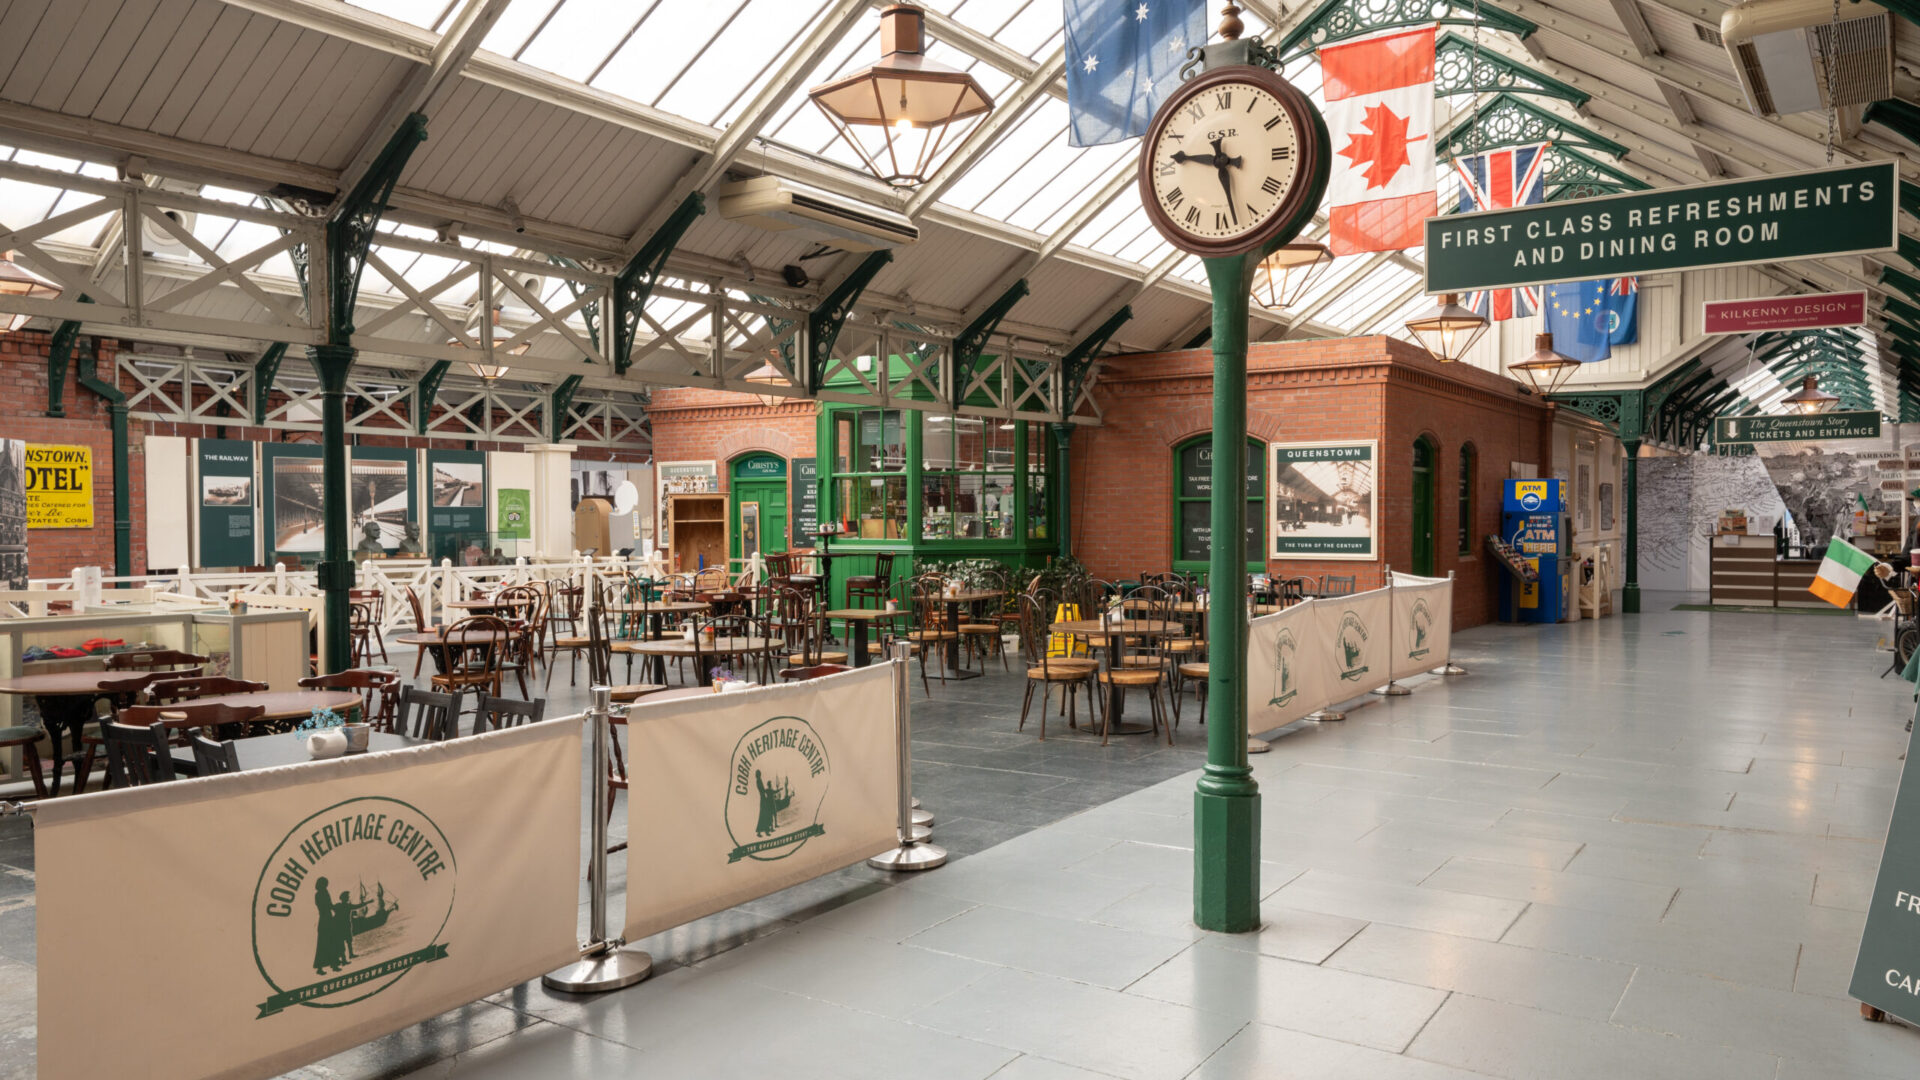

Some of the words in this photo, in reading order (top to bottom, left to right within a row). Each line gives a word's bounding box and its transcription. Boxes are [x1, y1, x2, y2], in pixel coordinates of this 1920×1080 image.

[1215, 92, 1232, 111] XII
[1186, 103, 1206, 124] XI
[1264, 115, 1281, 131] II
[1168, 130, 1184, 144] X
[1272, 147, 1289, 160] III
[1166, 187, 1185, 211] VIII
[1185, 205, 1201, 227] VII
[1441, 225, 1512, 249] FIRST
[1527, 213, 1612, 239] CLASS
[1628, 181, 1875, 228] REFRESHMENTS
[1513, 246, 1564, 267] AND
[1581, 233, 1676, 260] DINING
[1694, 222, 1778, 249] ROOM
[1721, 307, 1789, 319] KILKENNY
[1794, 303, 1847, 314] DESIGN
[1750, 420, 1766, 429] The
[1768, 418, 1823, 431] Queenstown
[1825, 416, 1850, 428] Story
[1750, 431, 1791, 439] TICKETS
[1795, 429, 1815, 437] AND
[1819, 427, 1874, 437] ENTRANCE
[25, 449, 87, 463] NSTOWN.
[1200, 449, 1213, 460] CH
[1287, 449, 1361, 458] QUEENSTOWN
[25, 465, 88, 491] OTEL”
[1524, 529, 1555, 540] ATM
[1525, 543, 1554, 553] HERE
[735, 754, 752, 795] COBH
[747, 728, 799, 760] HERITAGE
[798, 734, 825, 778] CENTRE
[266, 857, 308, 917] COBH
[300, 813, 387, 865] HERITAGE
[387, 819, 446, 881] CENTRE
[1895, 890, 1920, 915] FR
[300, 987, 318, 999] THE
[322, 966, 382, 992] QUEENSTOWN
[386, 957, 414, 972] STORY
